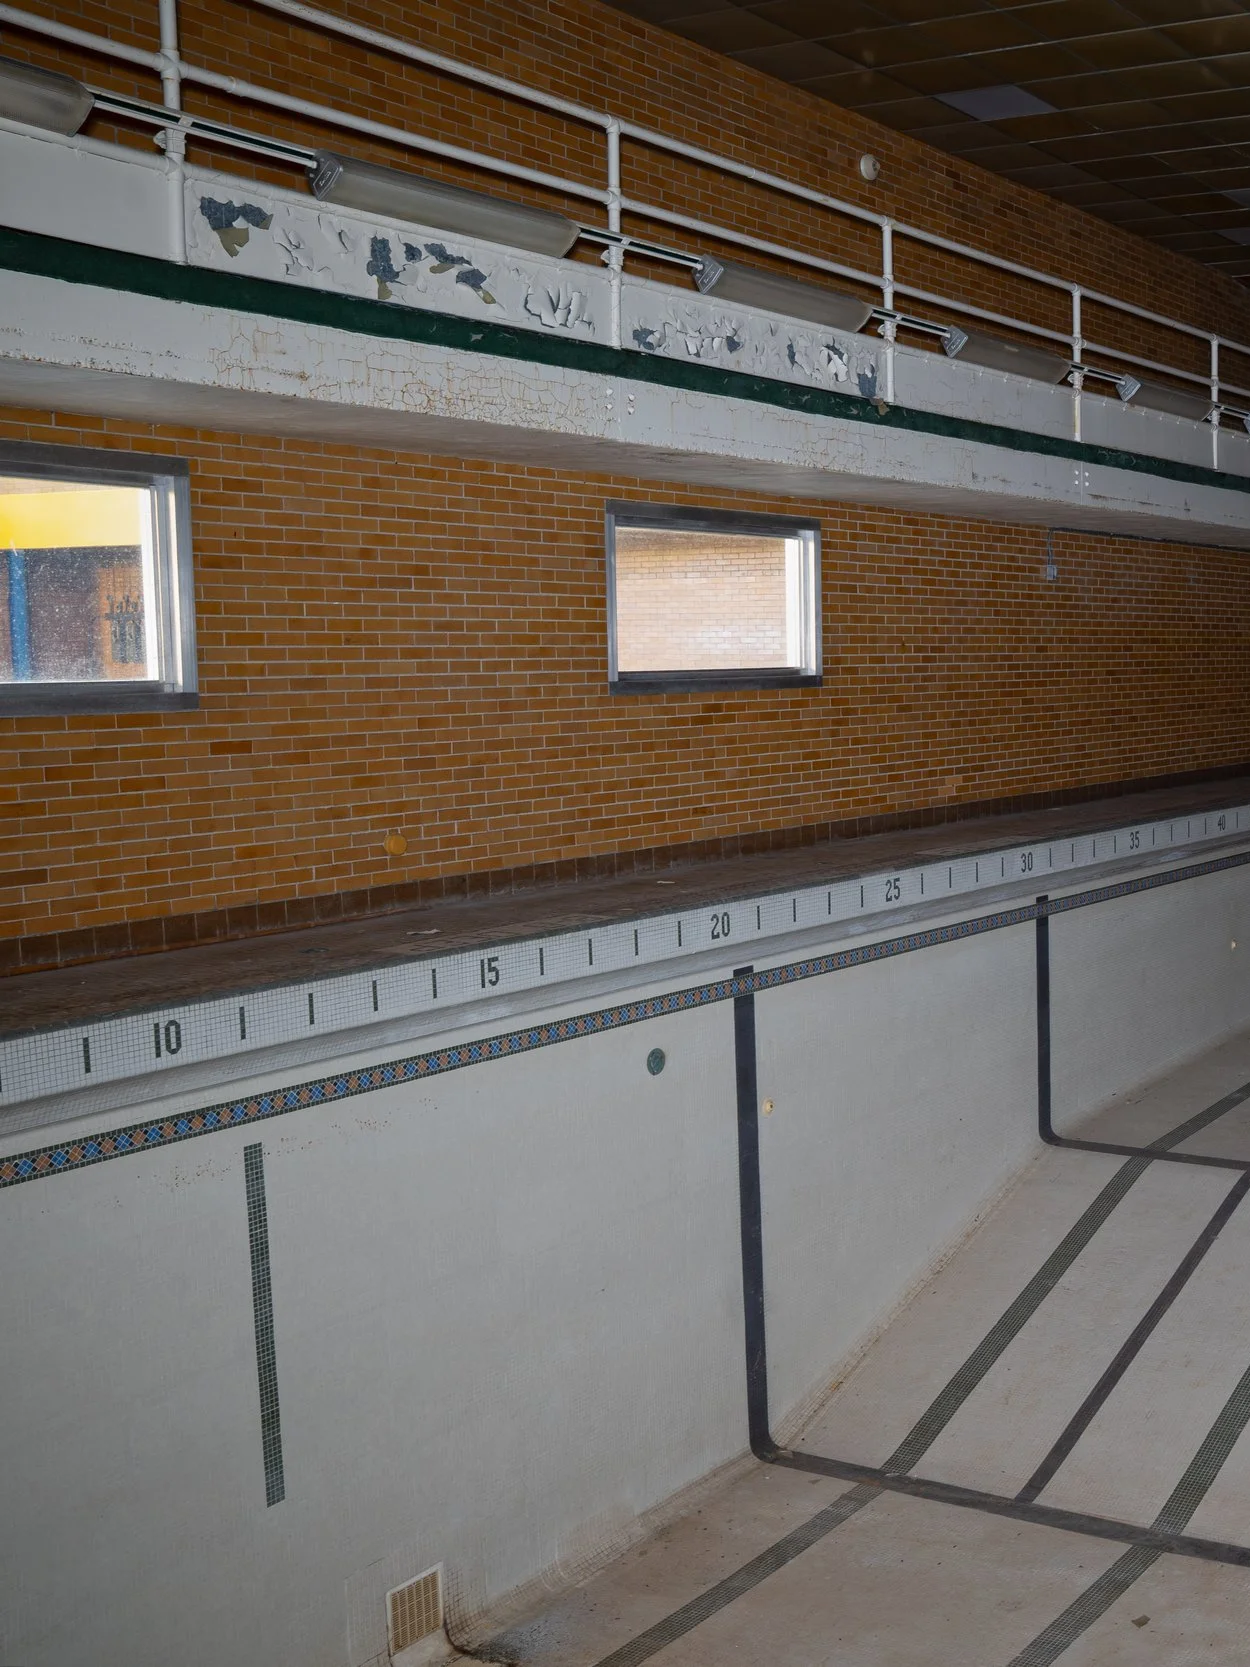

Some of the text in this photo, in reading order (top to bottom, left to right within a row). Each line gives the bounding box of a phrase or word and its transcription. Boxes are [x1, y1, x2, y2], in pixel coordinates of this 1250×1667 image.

[1217, 814, 1227, 832] 40
[1129, 831, 1140, 850] 35
[1020, 851, 1034, 873] 30
[885, 878, 901, 902] 25
[711, 912, 731, 940] 20
[480, 956, 501, 989] 15
[154, 1019, 182, 1058] 10
